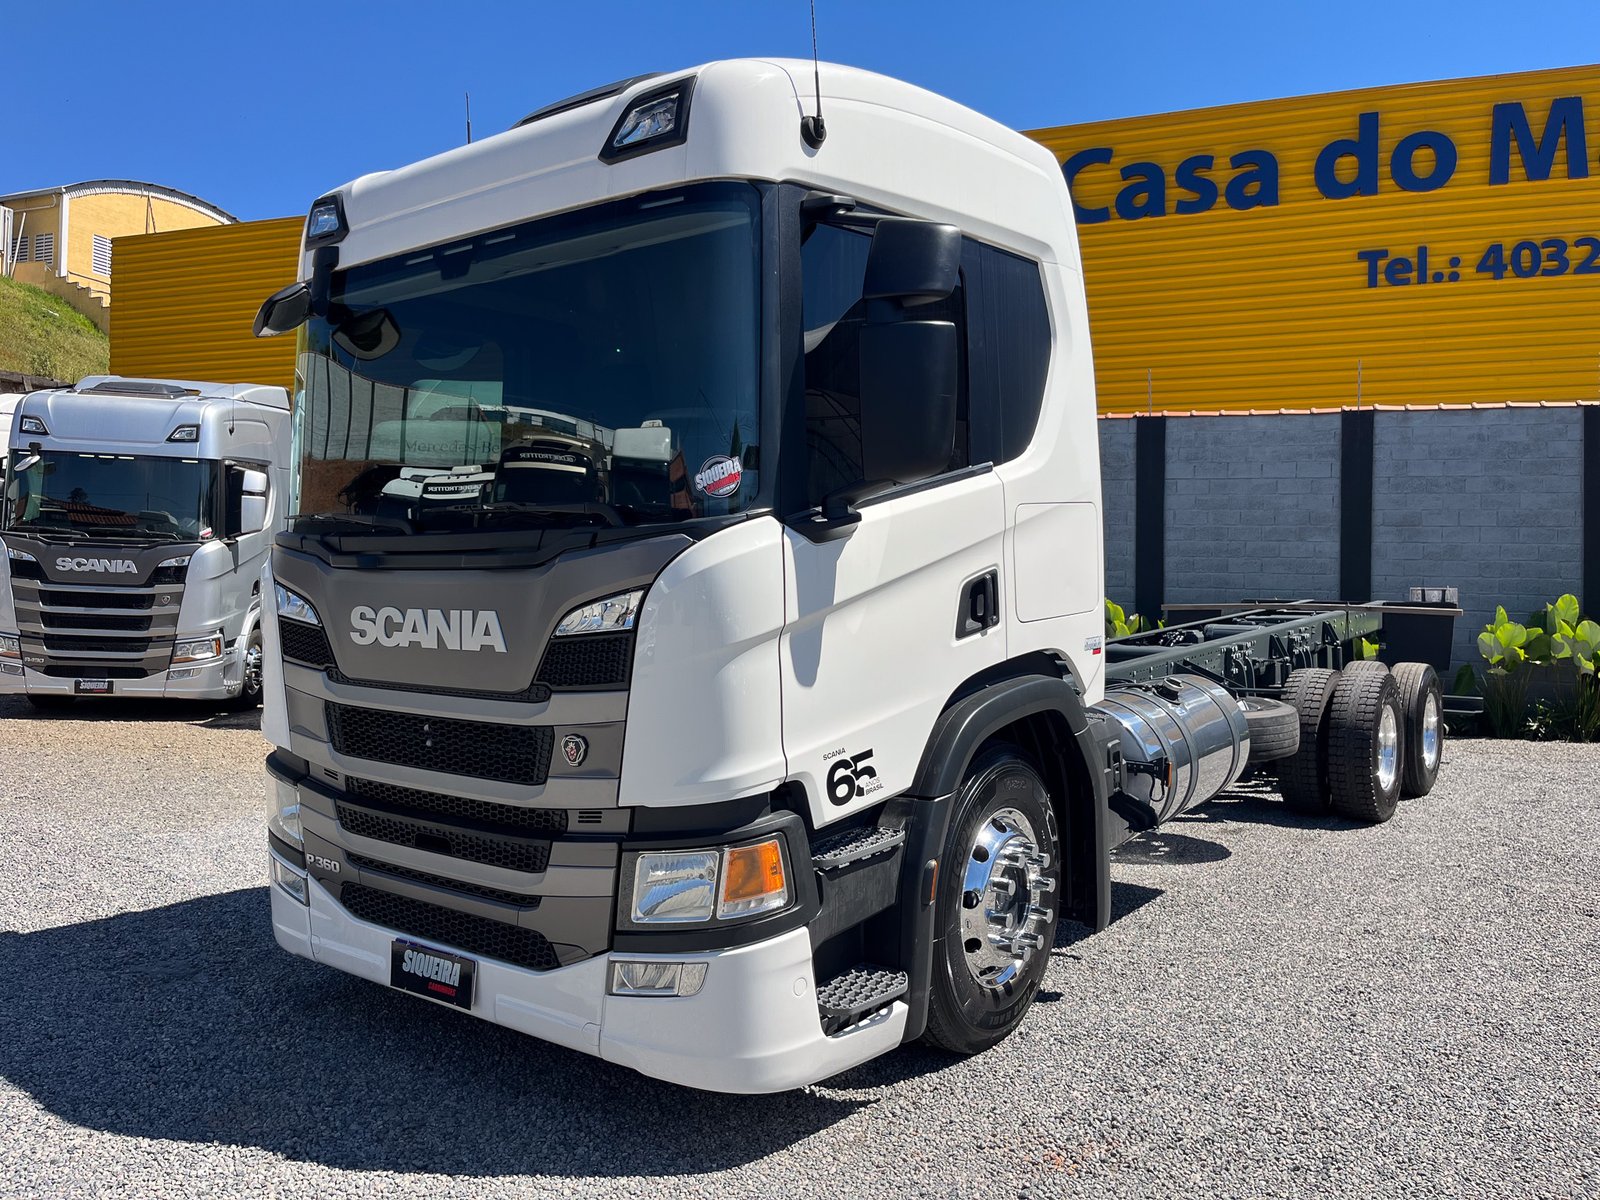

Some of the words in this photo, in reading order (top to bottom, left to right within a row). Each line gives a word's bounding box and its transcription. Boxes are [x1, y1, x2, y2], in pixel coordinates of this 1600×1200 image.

[1061, 147, 1279, 224] Casa
[1314, 111, 1457, 200] do
[1489, 96, 1600, 186] M
[1357, 246, 1460, 288] Tel.:
[1475, 236, 1600, 280] 4032
[695, 456, 742, 490] SIQUEIRA
[55, 557, 138, 574] SCANIA
[350, 605, 508, 653] SCANIA
[822, 747, 846, 761] SCANIA
[826, 748, 877, 806] 65
[865, 783, 884, 796] BRASIL
[402, 949, 462, 987] SIQUEIRA
